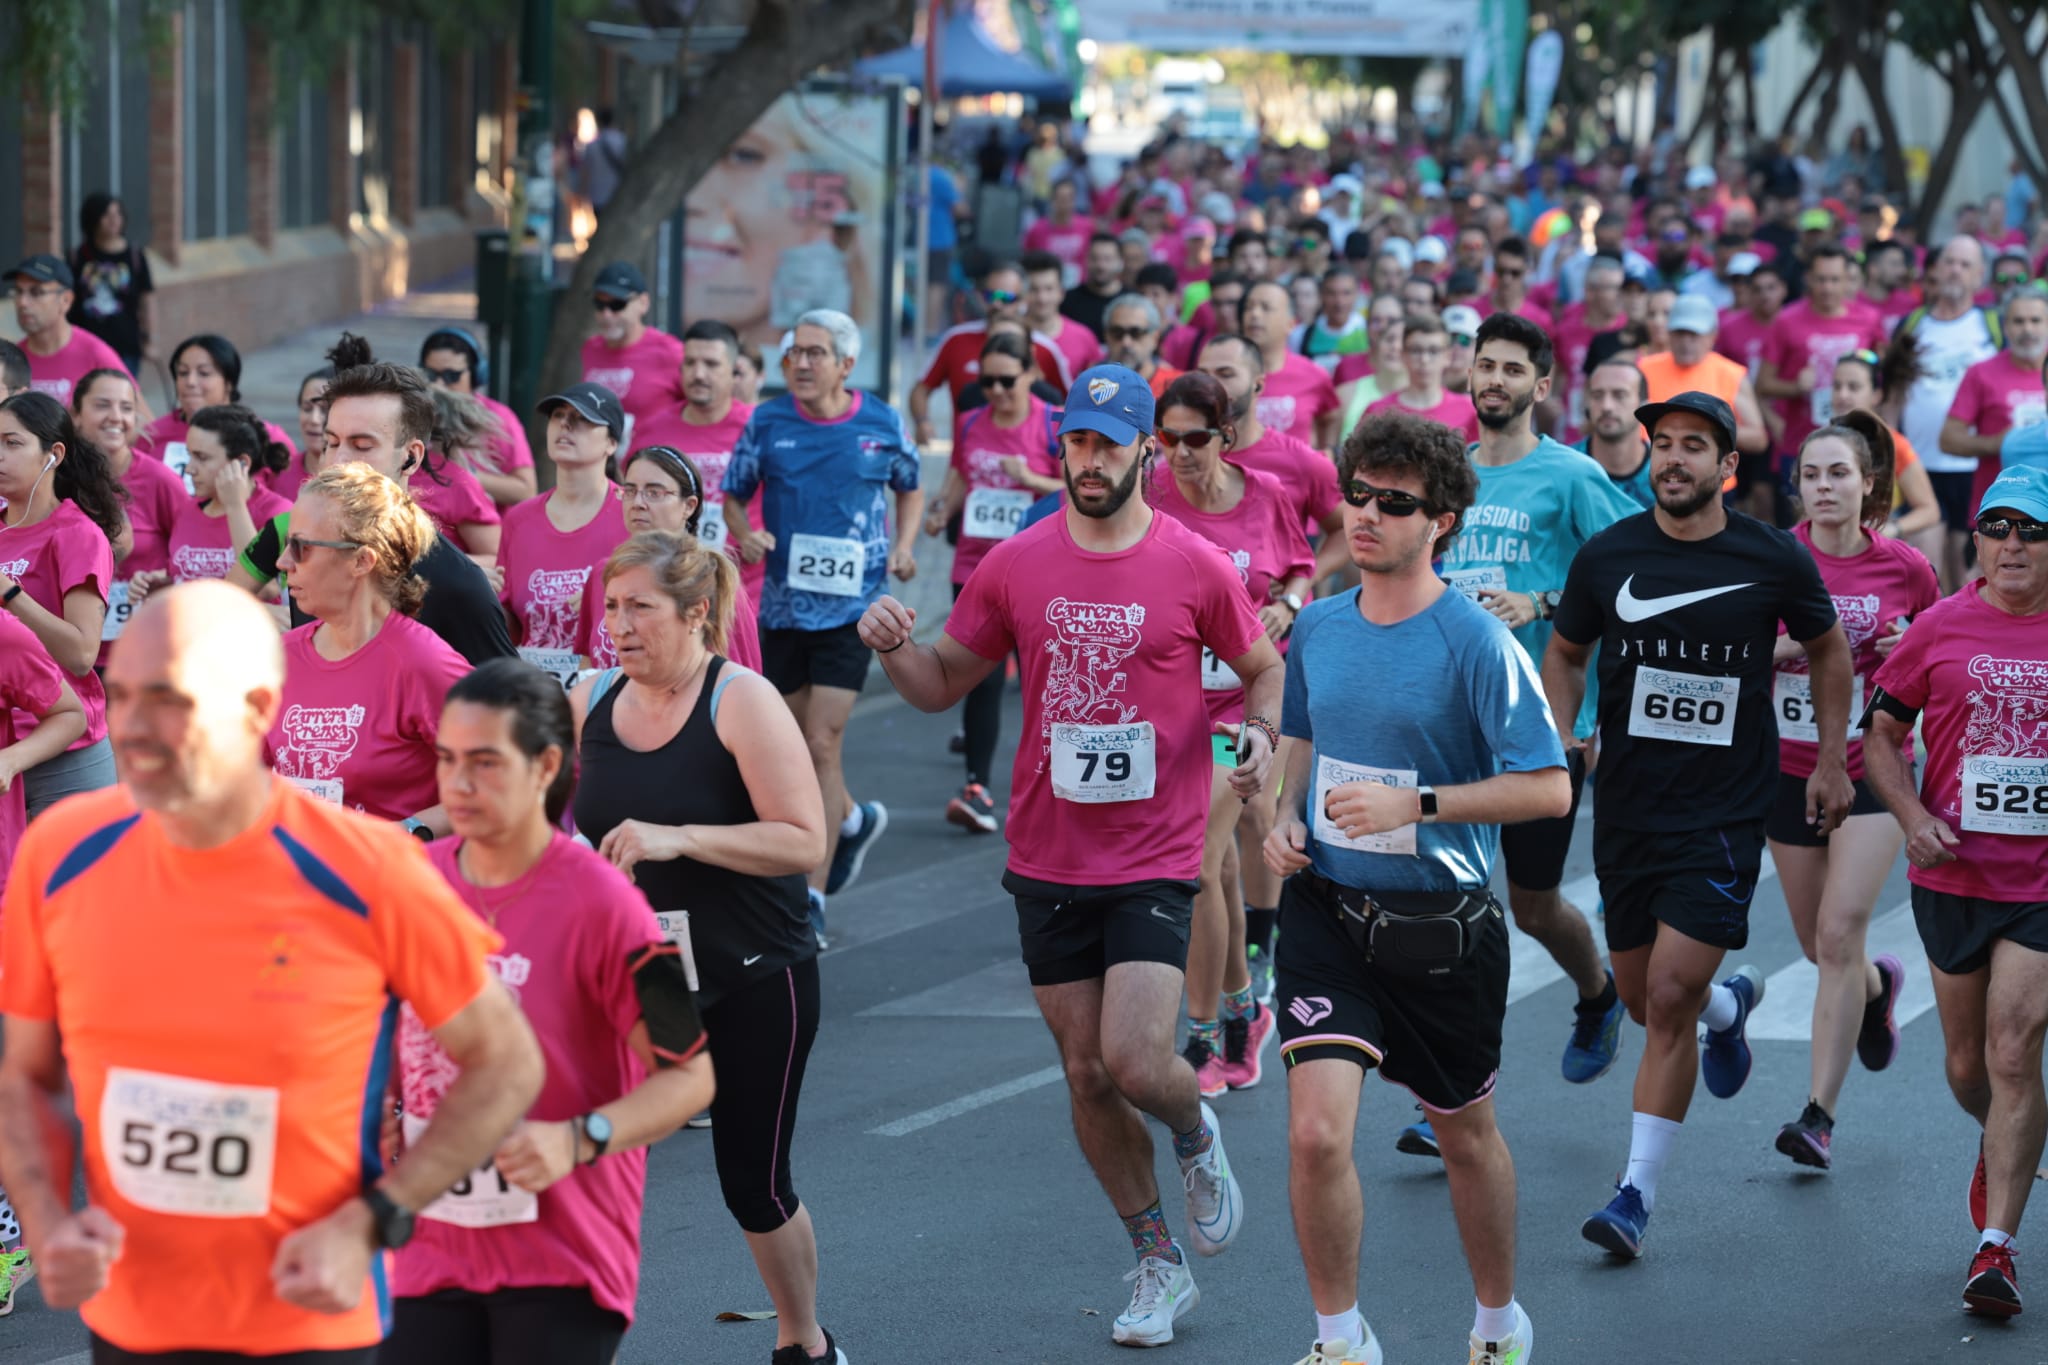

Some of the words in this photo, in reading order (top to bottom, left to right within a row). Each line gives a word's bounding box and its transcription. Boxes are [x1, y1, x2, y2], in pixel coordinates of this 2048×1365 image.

[1464, 505, 1530, 533] ERSIDAD
[799, 556, 855, 580] 234
[1048, 600, 1127, 621] Carrera
[1062, 618, 1132, 638] Prensa
[287, 708, 347, 727] Carrera
[1645, 693, 1725, 725] 660
[294, 725, 350, 740] Prensa
[1069, 729, 1128, 742] Carrera
[1076, 752, 1131, 782] 79
[123, 1120, 250, 1177] 520
